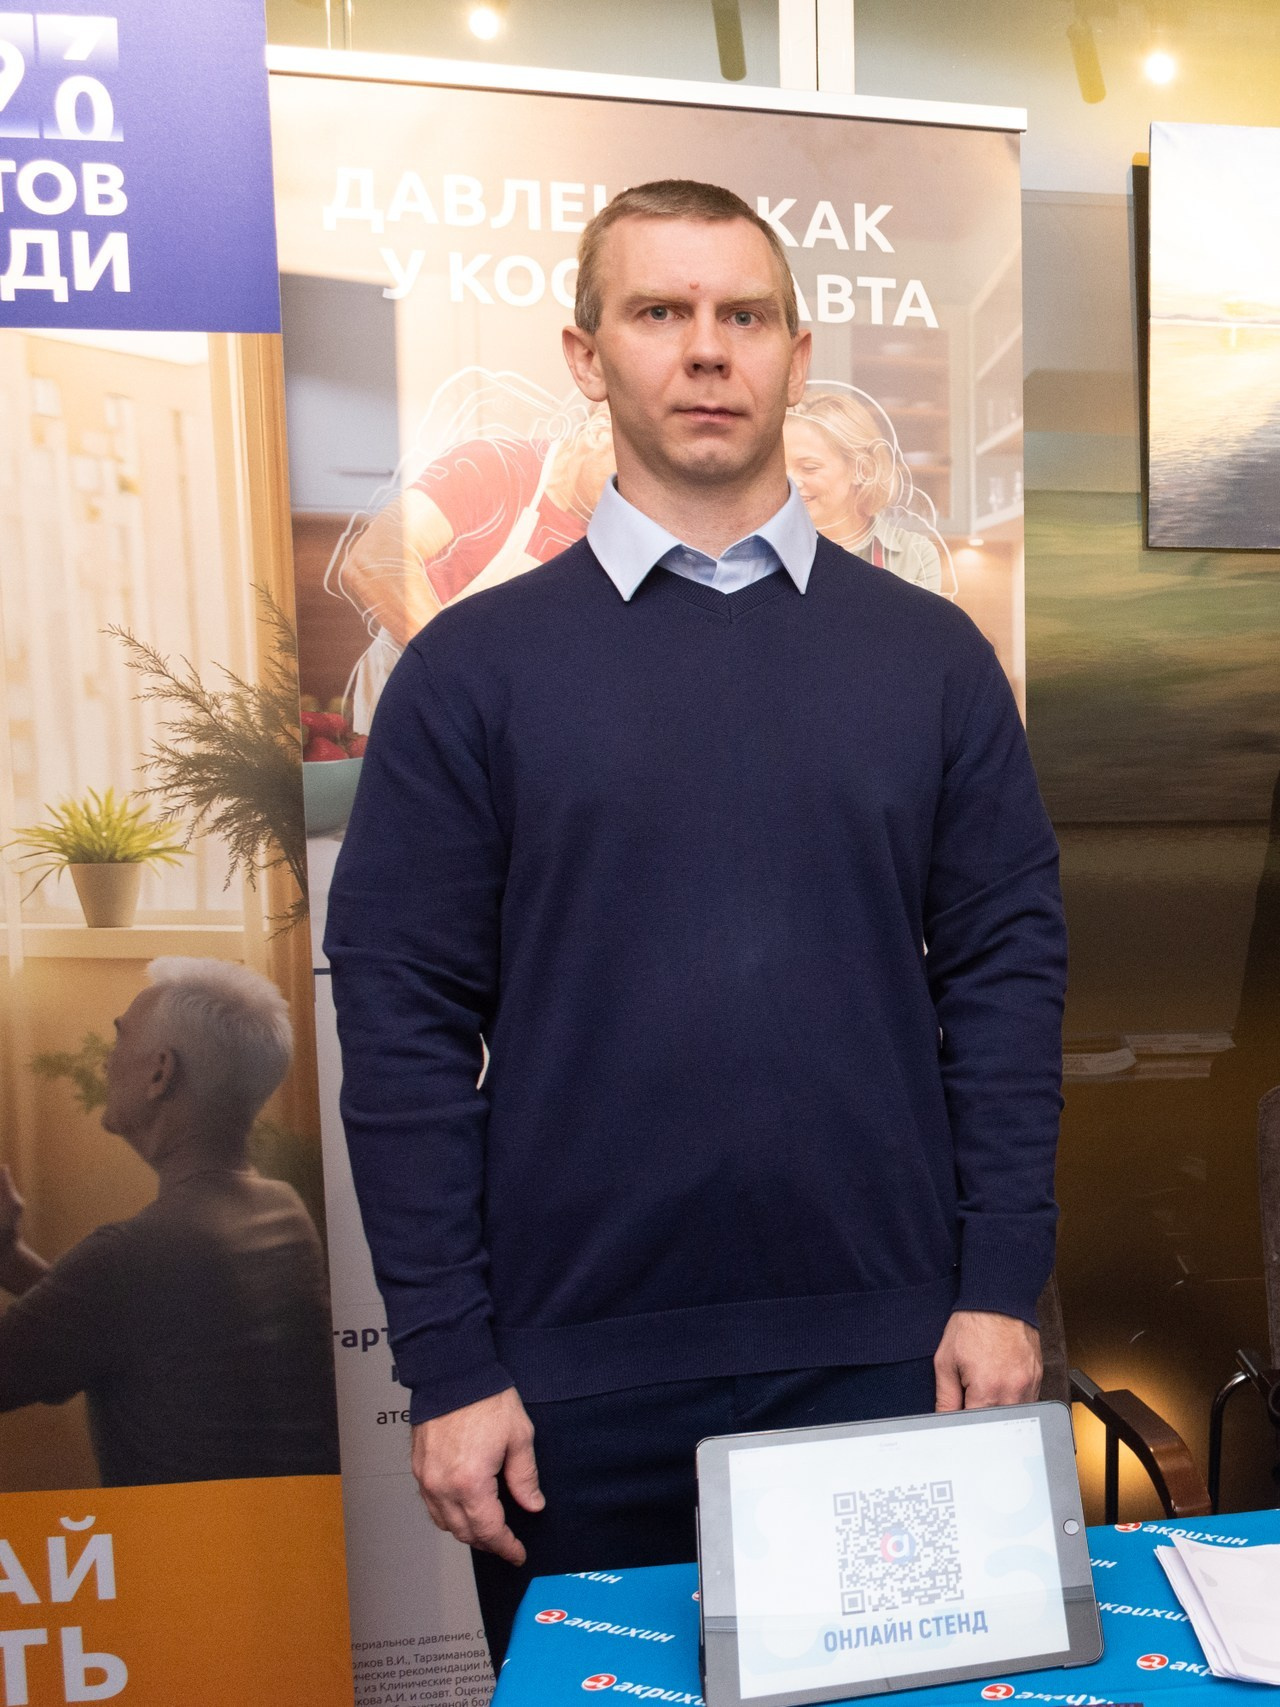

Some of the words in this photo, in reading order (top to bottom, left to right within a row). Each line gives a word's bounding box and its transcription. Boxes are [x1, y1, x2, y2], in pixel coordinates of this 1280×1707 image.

[757, 196, 896, 253] КАК
[378, 248, 426, 300] У
[1142, 1524, 1249, 1546] акрихин
[1097, 1601, 1193, 1622] крихи
[417, 1632, 474, 1646] давление,
[564, 1617, 676, 1643] акрихин
[824, 1617, 913, 1652] ОНЛАЙН
[919, 1610, 989, 1639] СТЕНД
[0, 1626, 129, 1707] ТЬ
[413, 1649, 486, 1664] Тарзиманова
[399, 1663, 480, 1679] рекомендации
[364, 1685, 377, 1693] из
[379, 1677, 452, 1691] Клинические
[419, 1690, 451, 1700] соавт.
[454, 1684, 495, 1697] Оценка
